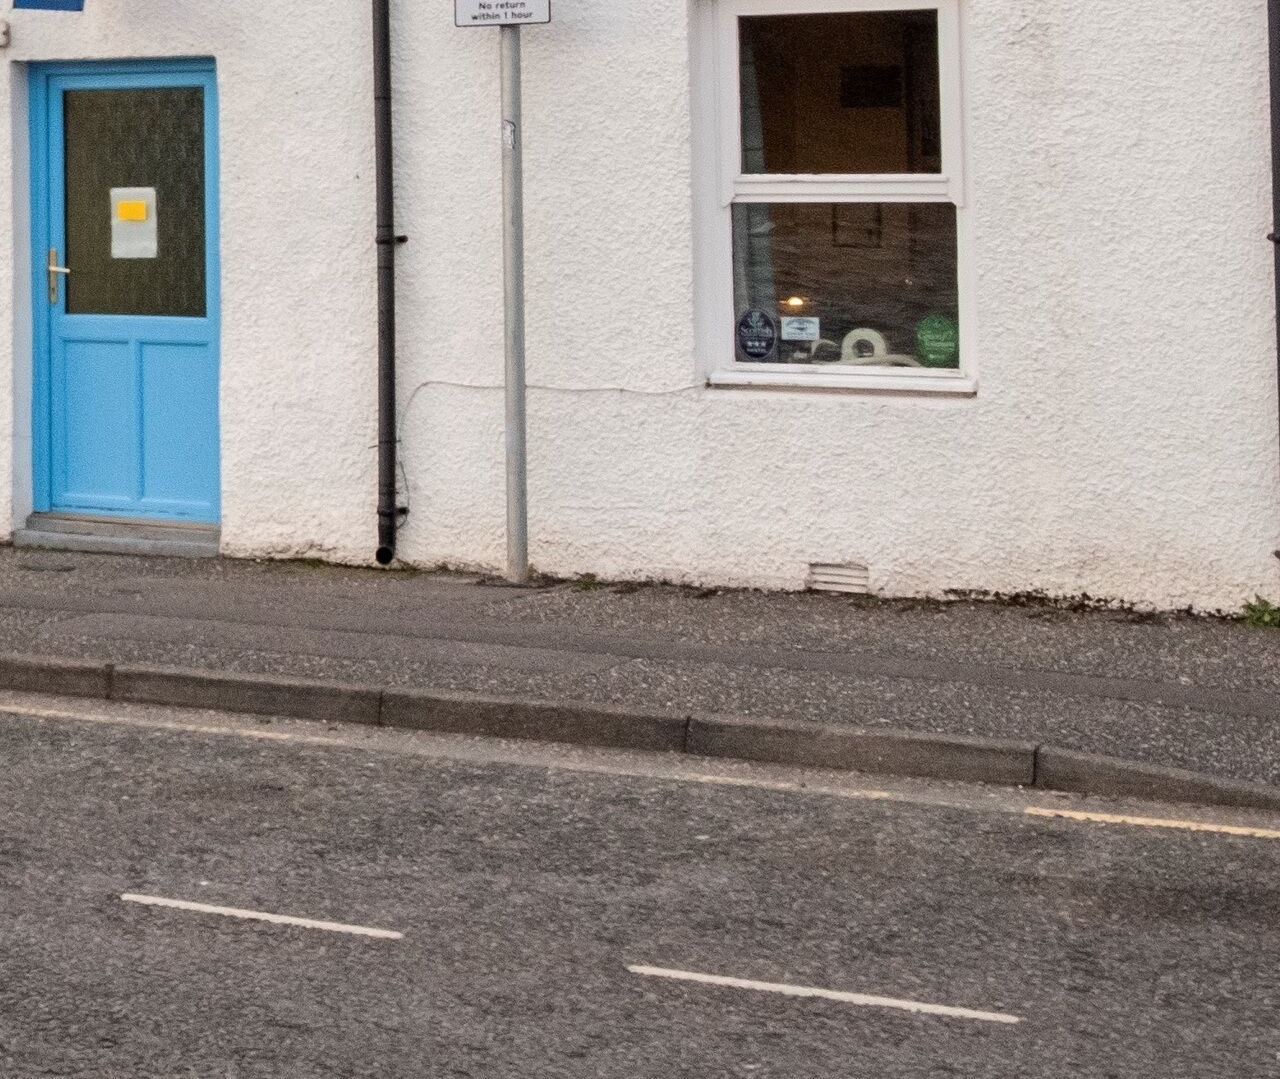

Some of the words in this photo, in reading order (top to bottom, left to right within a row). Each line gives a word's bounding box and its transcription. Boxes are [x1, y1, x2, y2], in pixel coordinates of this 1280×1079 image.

[496, 1, 526, 9] return
[471, 13, 500, 21] within
[511, 11, 533, 19] hour
